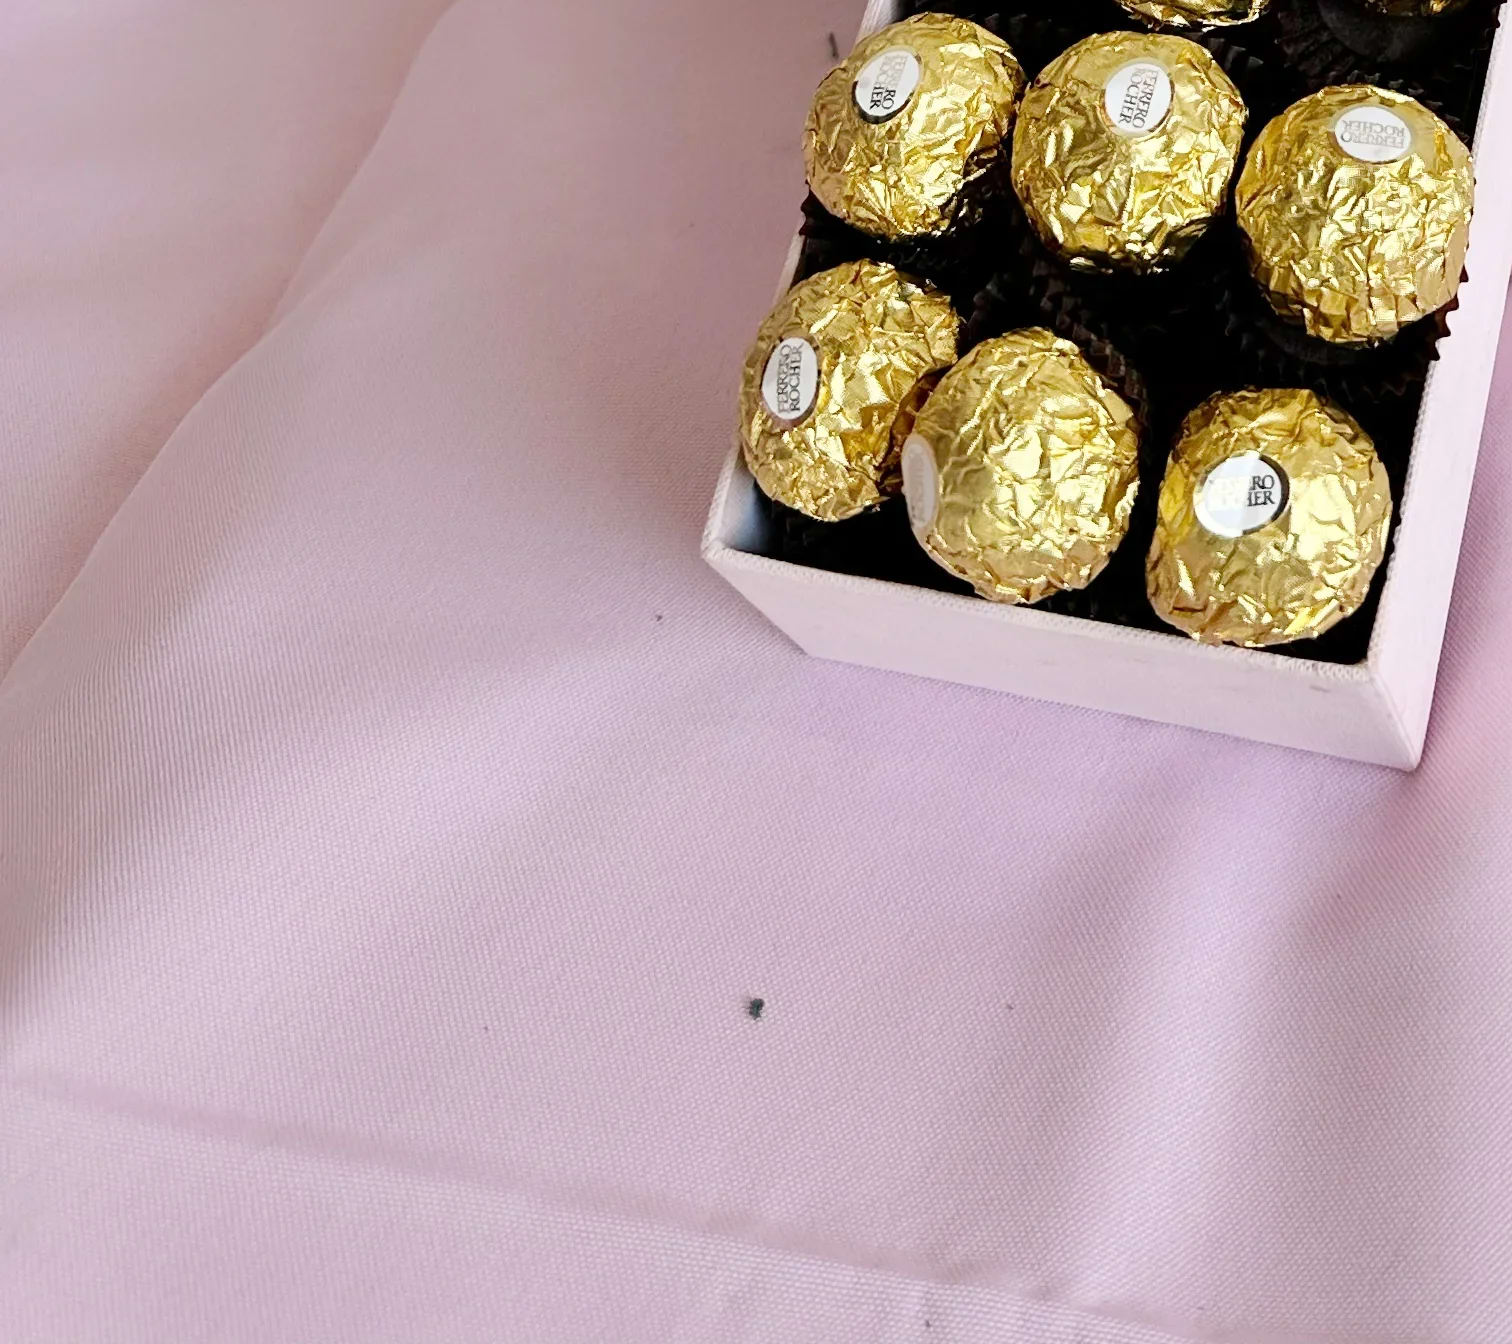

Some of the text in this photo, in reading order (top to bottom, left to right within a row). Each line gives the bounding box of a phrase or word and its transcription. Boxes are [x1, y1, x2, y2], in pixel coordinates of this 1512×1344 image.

[1118, 68, 1145, 124] ROCHER
[1132, 69, 1158, 129] FERRERO
[1340, 131, 1404, 149] FERRERO
[1342, 119, 1405, 137] ROCHER
[776, 344, 792, 413] FERRERO
[789, 342, 804, 412] ROCHER
